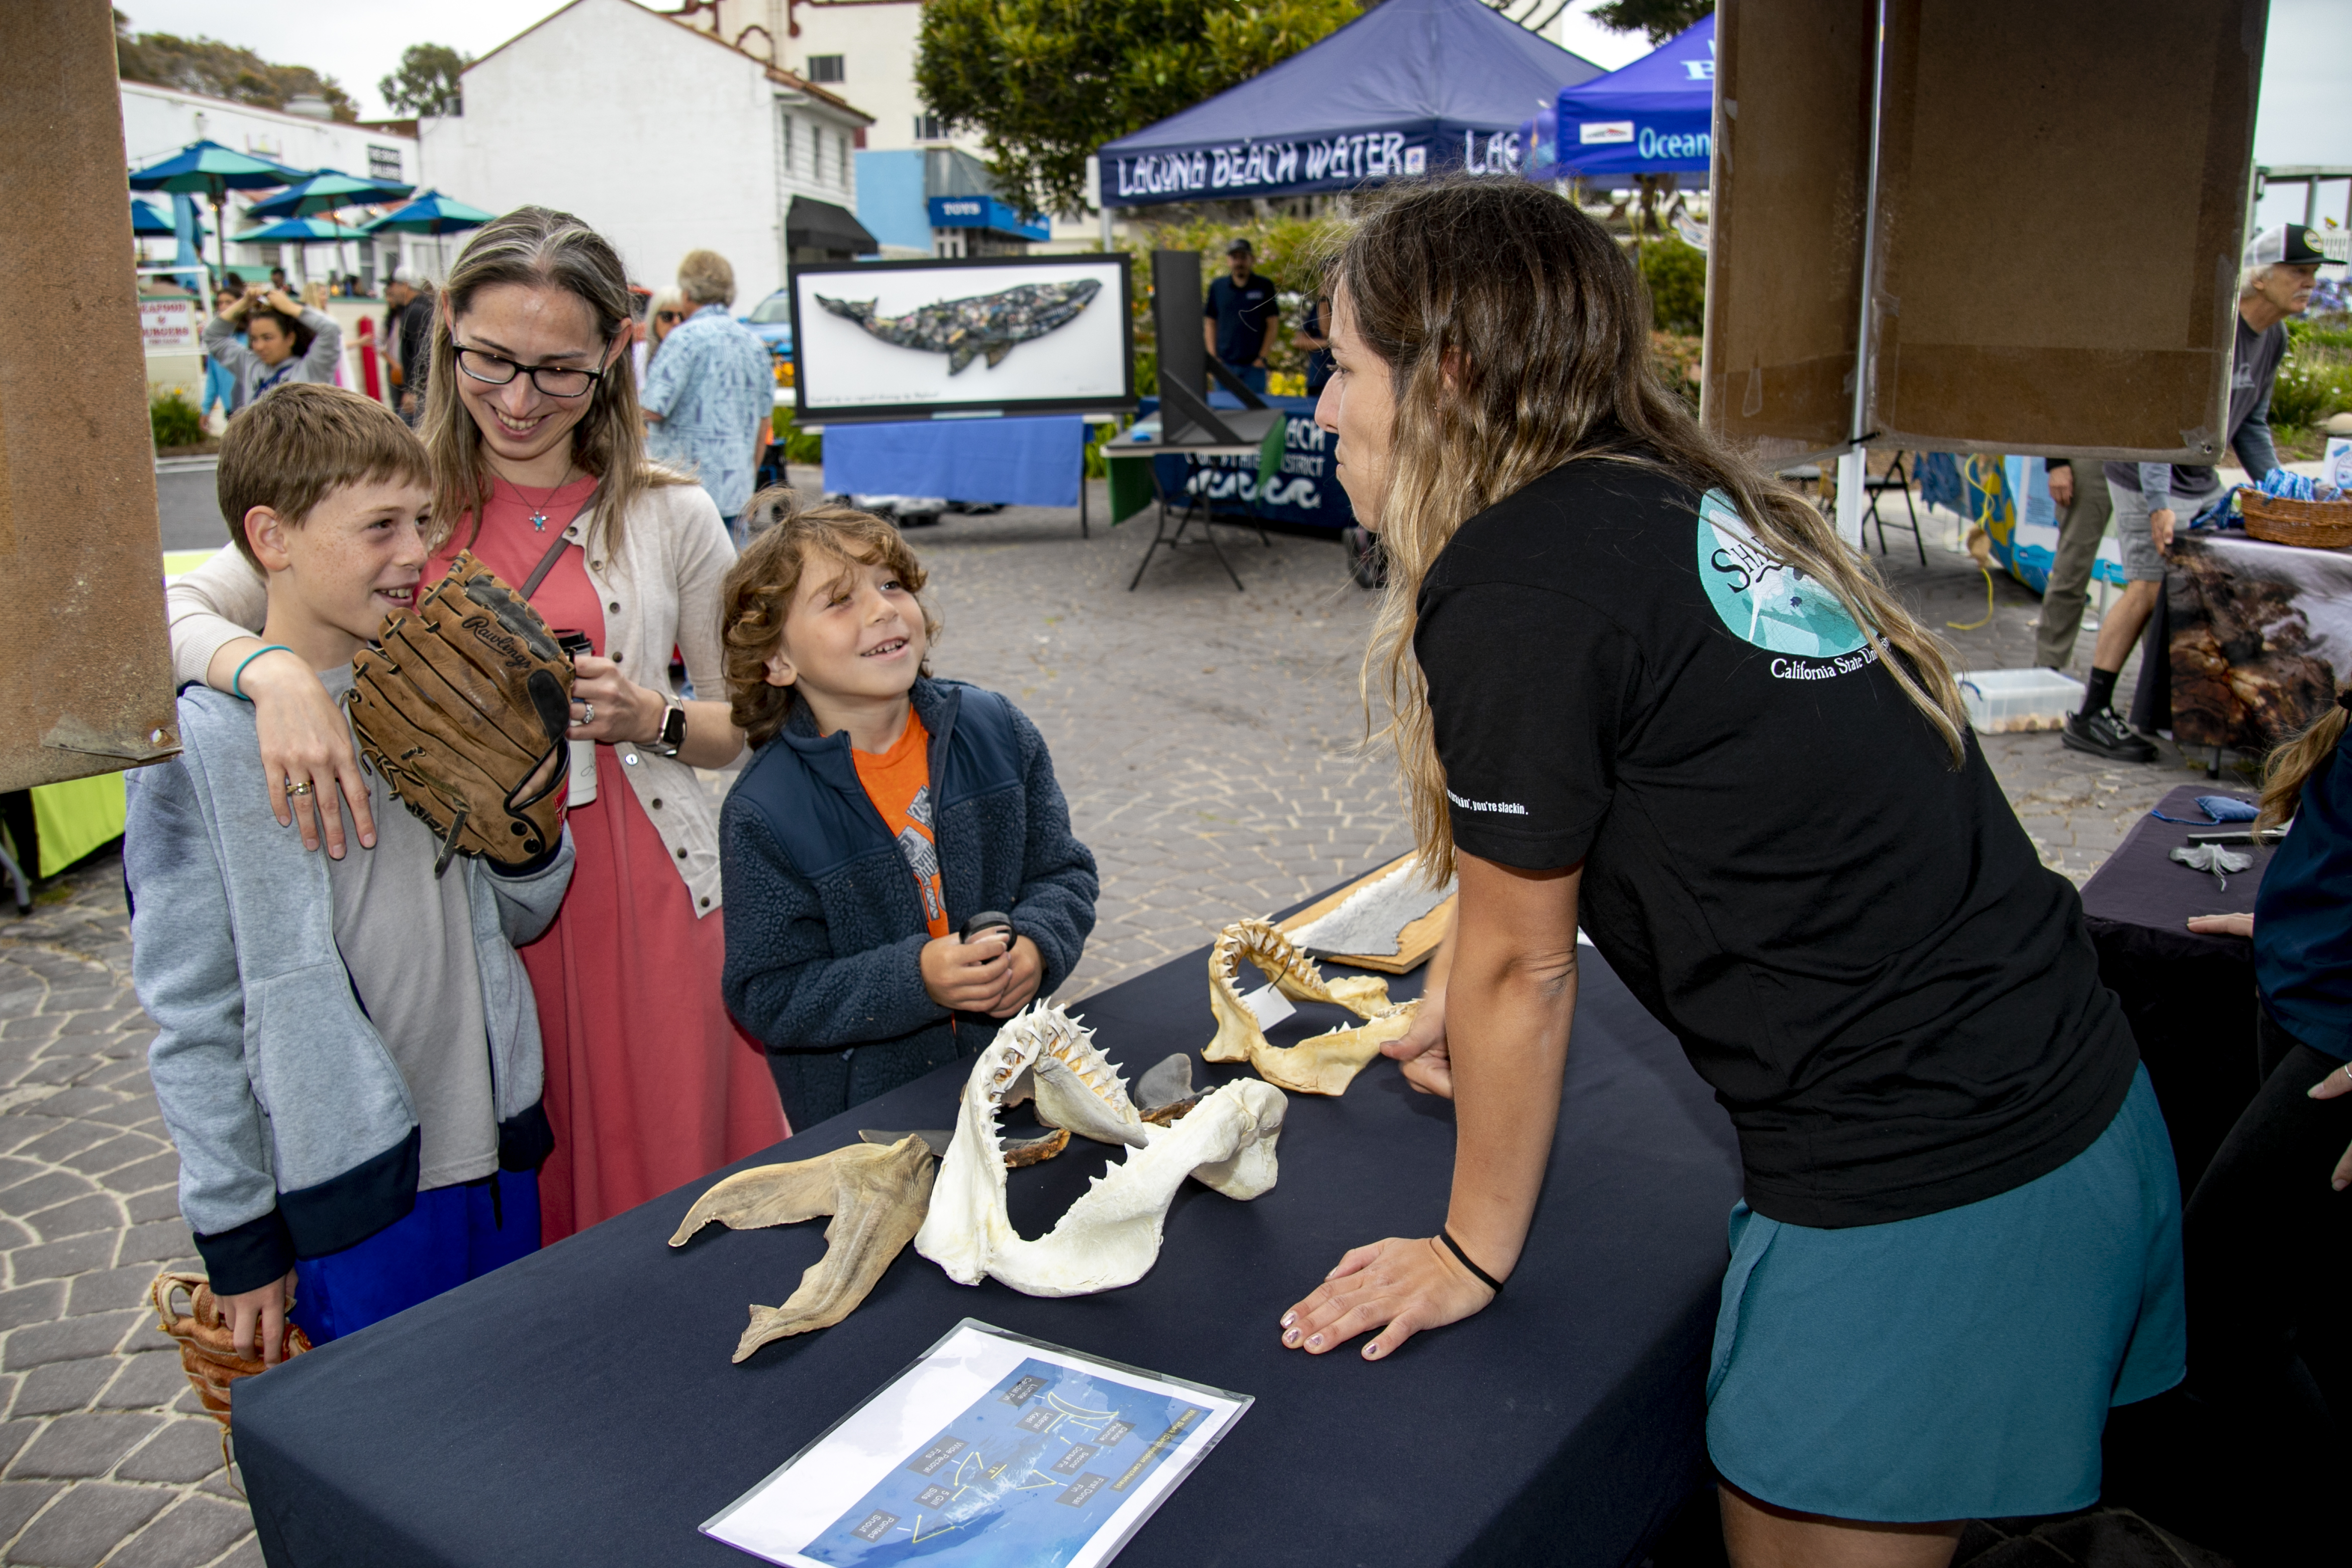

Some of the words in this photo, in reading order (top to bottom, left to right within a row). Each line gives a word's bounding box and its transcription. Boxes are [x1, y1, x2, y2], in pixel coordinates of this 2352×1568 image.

[1465, 129, 1520, 176] LAG
[1117, 150, 1207, 197] LAGUNA
[1211, 141, 1299, 188] BEACH
[1305, 131, 1405, 180] WATER
[941, 202, 981, 216] TOYS
[141, 303, 186, 313] EAFOOD
[142, 327, 188, 336] URGERS
[1285, 418, 1325, 451] ACH
[1281, 454, 1325, 476] ISTRICT
[461, 616, 531, 668] Rawlings
[1770, 658, 1836, 680] California
[1834, 657, 1863, 674] State
[1473, 801, 1497, 811] you're
[1011, 1378, 1032, 1394] Caudal
[1018, 1384, 1038, 1399] Lunate
[1003, 1393, 1015, 1401] Fin
[1025, 1411, 1040, 1424] Keel
[1032, 1413, 1053, 1429] Lateral
[1181, 1409, 1197, 1422] White
[1099, 1423, 1121, 1441] Peduncle
[1110, 1427, 1128, 1441] Caudal
[1168, 1421, 1184, 1434] Shark
[925, 1448, 941, 1458] Fins
[946, 1442, 964, 1454] Wide
[1065, 1446, 1083, 1461] Dorsal
[1140, 1433, 1172, 1463] (Carcharodon
[923, 1453, 949, 1473] Pectoral
[1069, 1452, 1089, 1468] Second
[1088, 1477, 1104, 1489] First
[1114, 1463, 1141, 1489] carcharias)
[921, 1487, 937, 1500] Slits
[1070, 1484, 1084, 1492] Fin
[930, 1495, 944, 1506] Gill
[1072, 1489, 1093, 1505] Dorsal
[859, 1514, 881, 1532] Snout
[867, 1516, 895, 1539] Pointed
